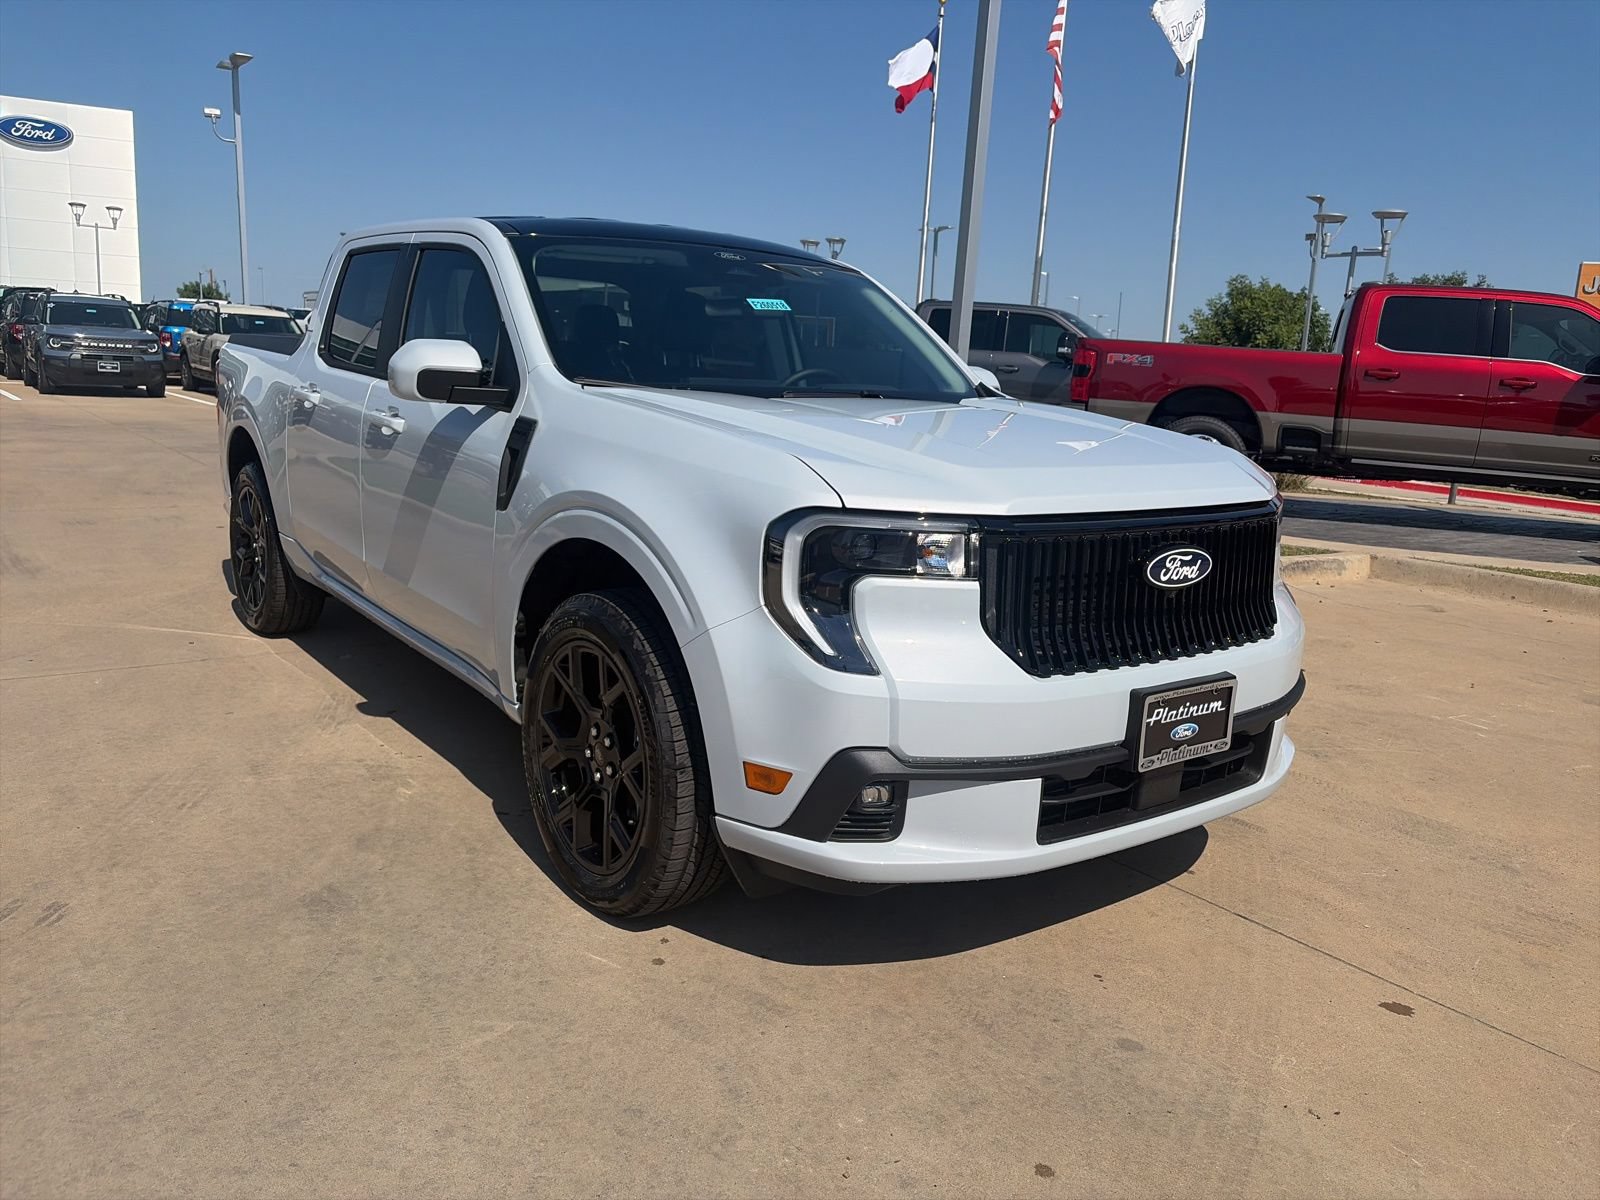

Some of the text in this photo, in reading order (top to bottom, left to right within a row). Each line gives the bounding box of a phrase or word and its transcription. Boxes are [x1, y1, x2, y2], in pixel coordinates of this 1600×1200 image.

[11, 120, 56, 140] Ford
[1106, 352, 1154, 366] FX4
[1160, 554, 1202, 582] Ford
[1145, 700, 1226, 726] Platinum
[1175, 726, 1194, 738] Ford
[1159, 744, 1212, 764] Platinum
